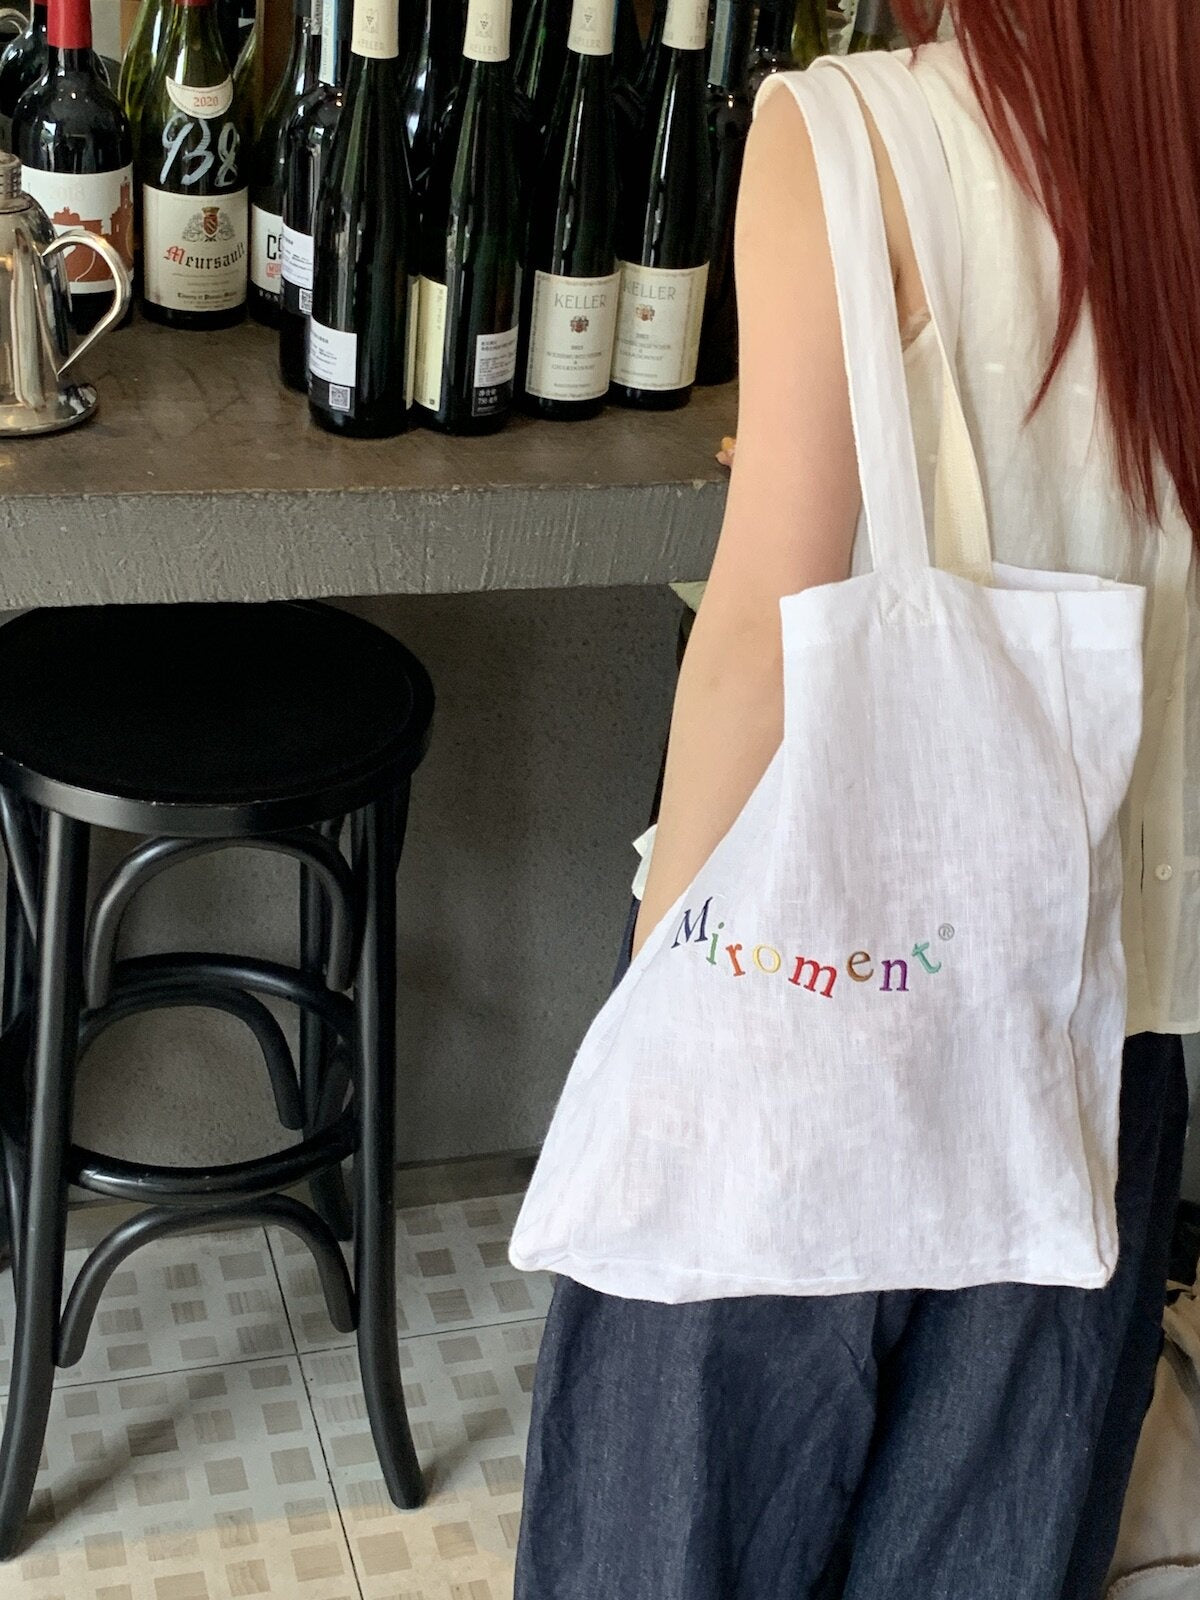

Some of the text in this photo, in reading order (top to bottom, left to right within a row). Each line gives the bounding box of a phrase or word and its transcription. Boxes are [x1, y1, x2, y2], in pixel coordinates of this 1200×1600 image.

[193, 96, 219, 107] 2020
[164, 242, 245, 270] Meursault
[554, 292, 606, 310] KELLER
